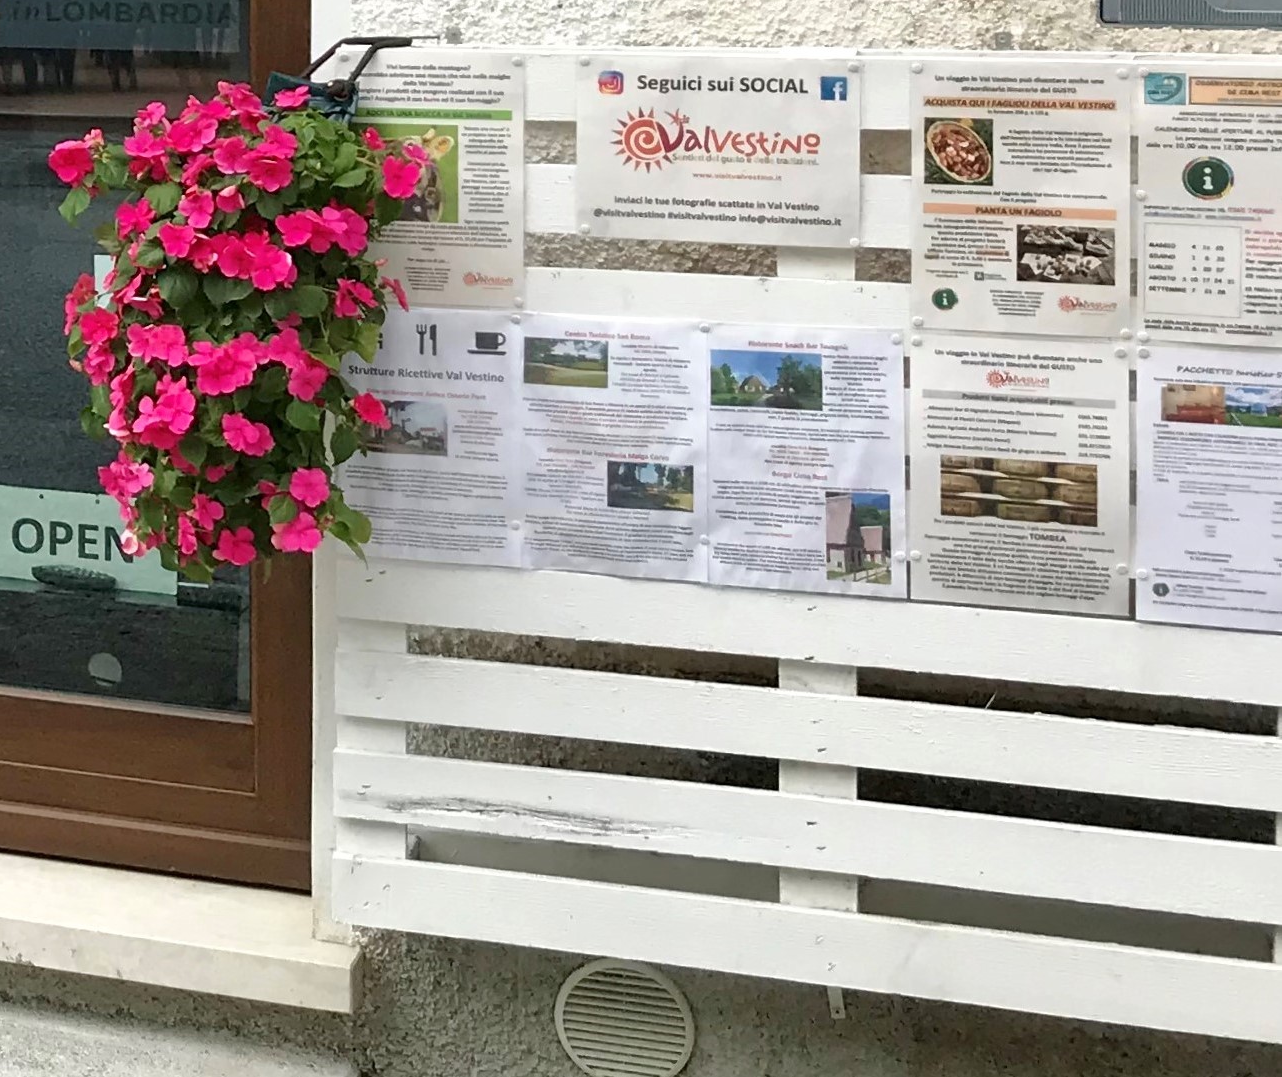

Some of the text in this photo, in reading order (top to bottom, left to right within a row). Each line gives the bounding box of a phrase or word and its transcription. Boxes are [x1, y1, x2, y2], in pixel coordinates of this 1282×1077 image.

[637, 75, 808, 94] Seguici sui SOCIAL
[924, 98, 967, 107] ACQUISTA
[968, 99, 984, 107] QUI
[1031, 100, 1057, 108] DELLA
[1059, 101, 1075, 109] VAL
[1078, 101, 1116, 110] VESTINO
[645, 196, 653, 205] le
[655, 197, 670, 205] tue
[672, 197, 717, 209] fotografie
[719, 199, 755, 208] scattate
[757, 200, 765, 209] in
[768, 202, 782, 210] Val
[784, 202, 819, 211] Vestino
[594, 208, 665, 219] @visitvalvestino
[738, 213, 841, 226] info@visitvalvestino.it
[348, 365, 504, 382] Strutture Ricettive Val Vestino
[1177, 366, 1233, 375] PACCHETTO
[12, 518, 134, 563] OPEN
[1028, 533, 1066, 542] TOMBEA
